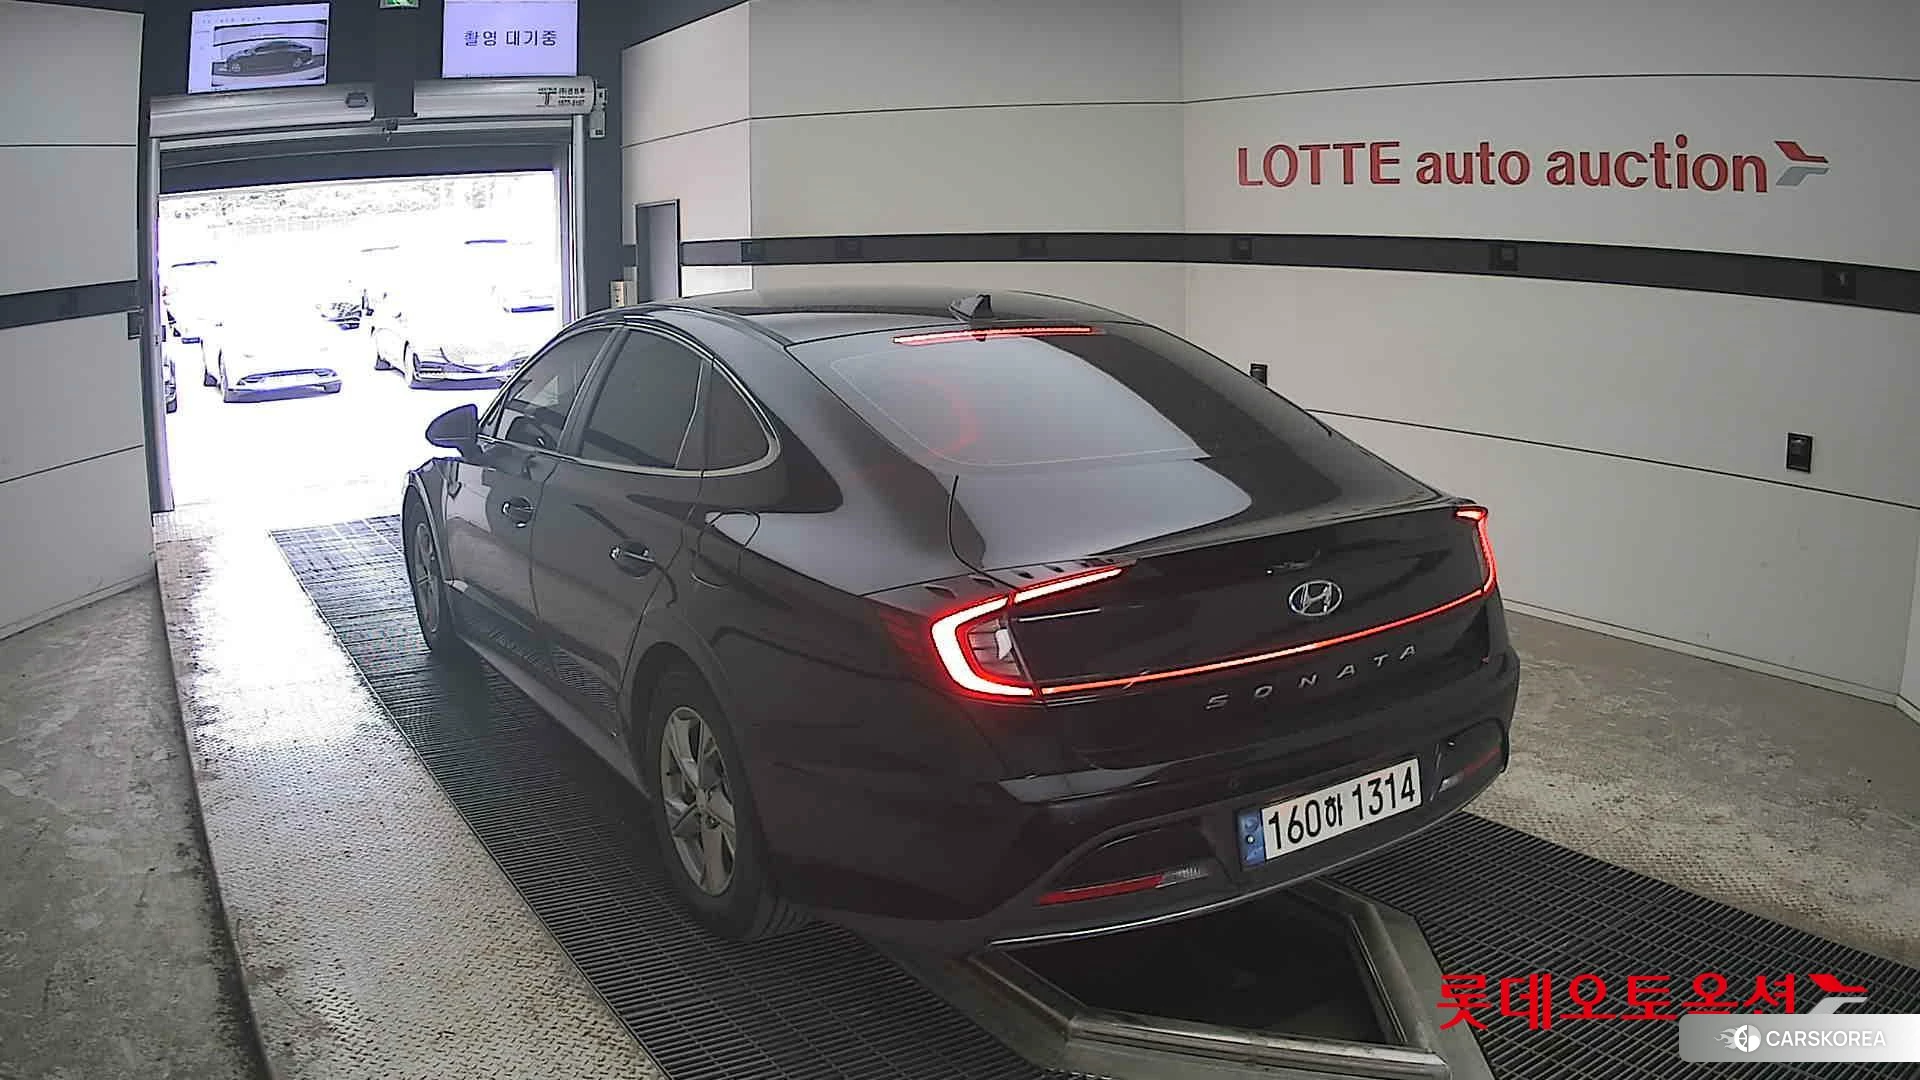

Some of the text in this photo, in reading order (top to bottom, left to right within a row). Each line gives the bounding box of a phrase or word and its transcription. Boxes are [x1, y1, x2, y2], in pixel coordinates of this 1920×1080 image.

[506, 29, 558, 47] 대기중
[1237, 134, 1768, 193] LOTTE auto auction
[1206, 646, 1416, 710] SONATA
[1268, 766, 1416, 850] 160하 1314
